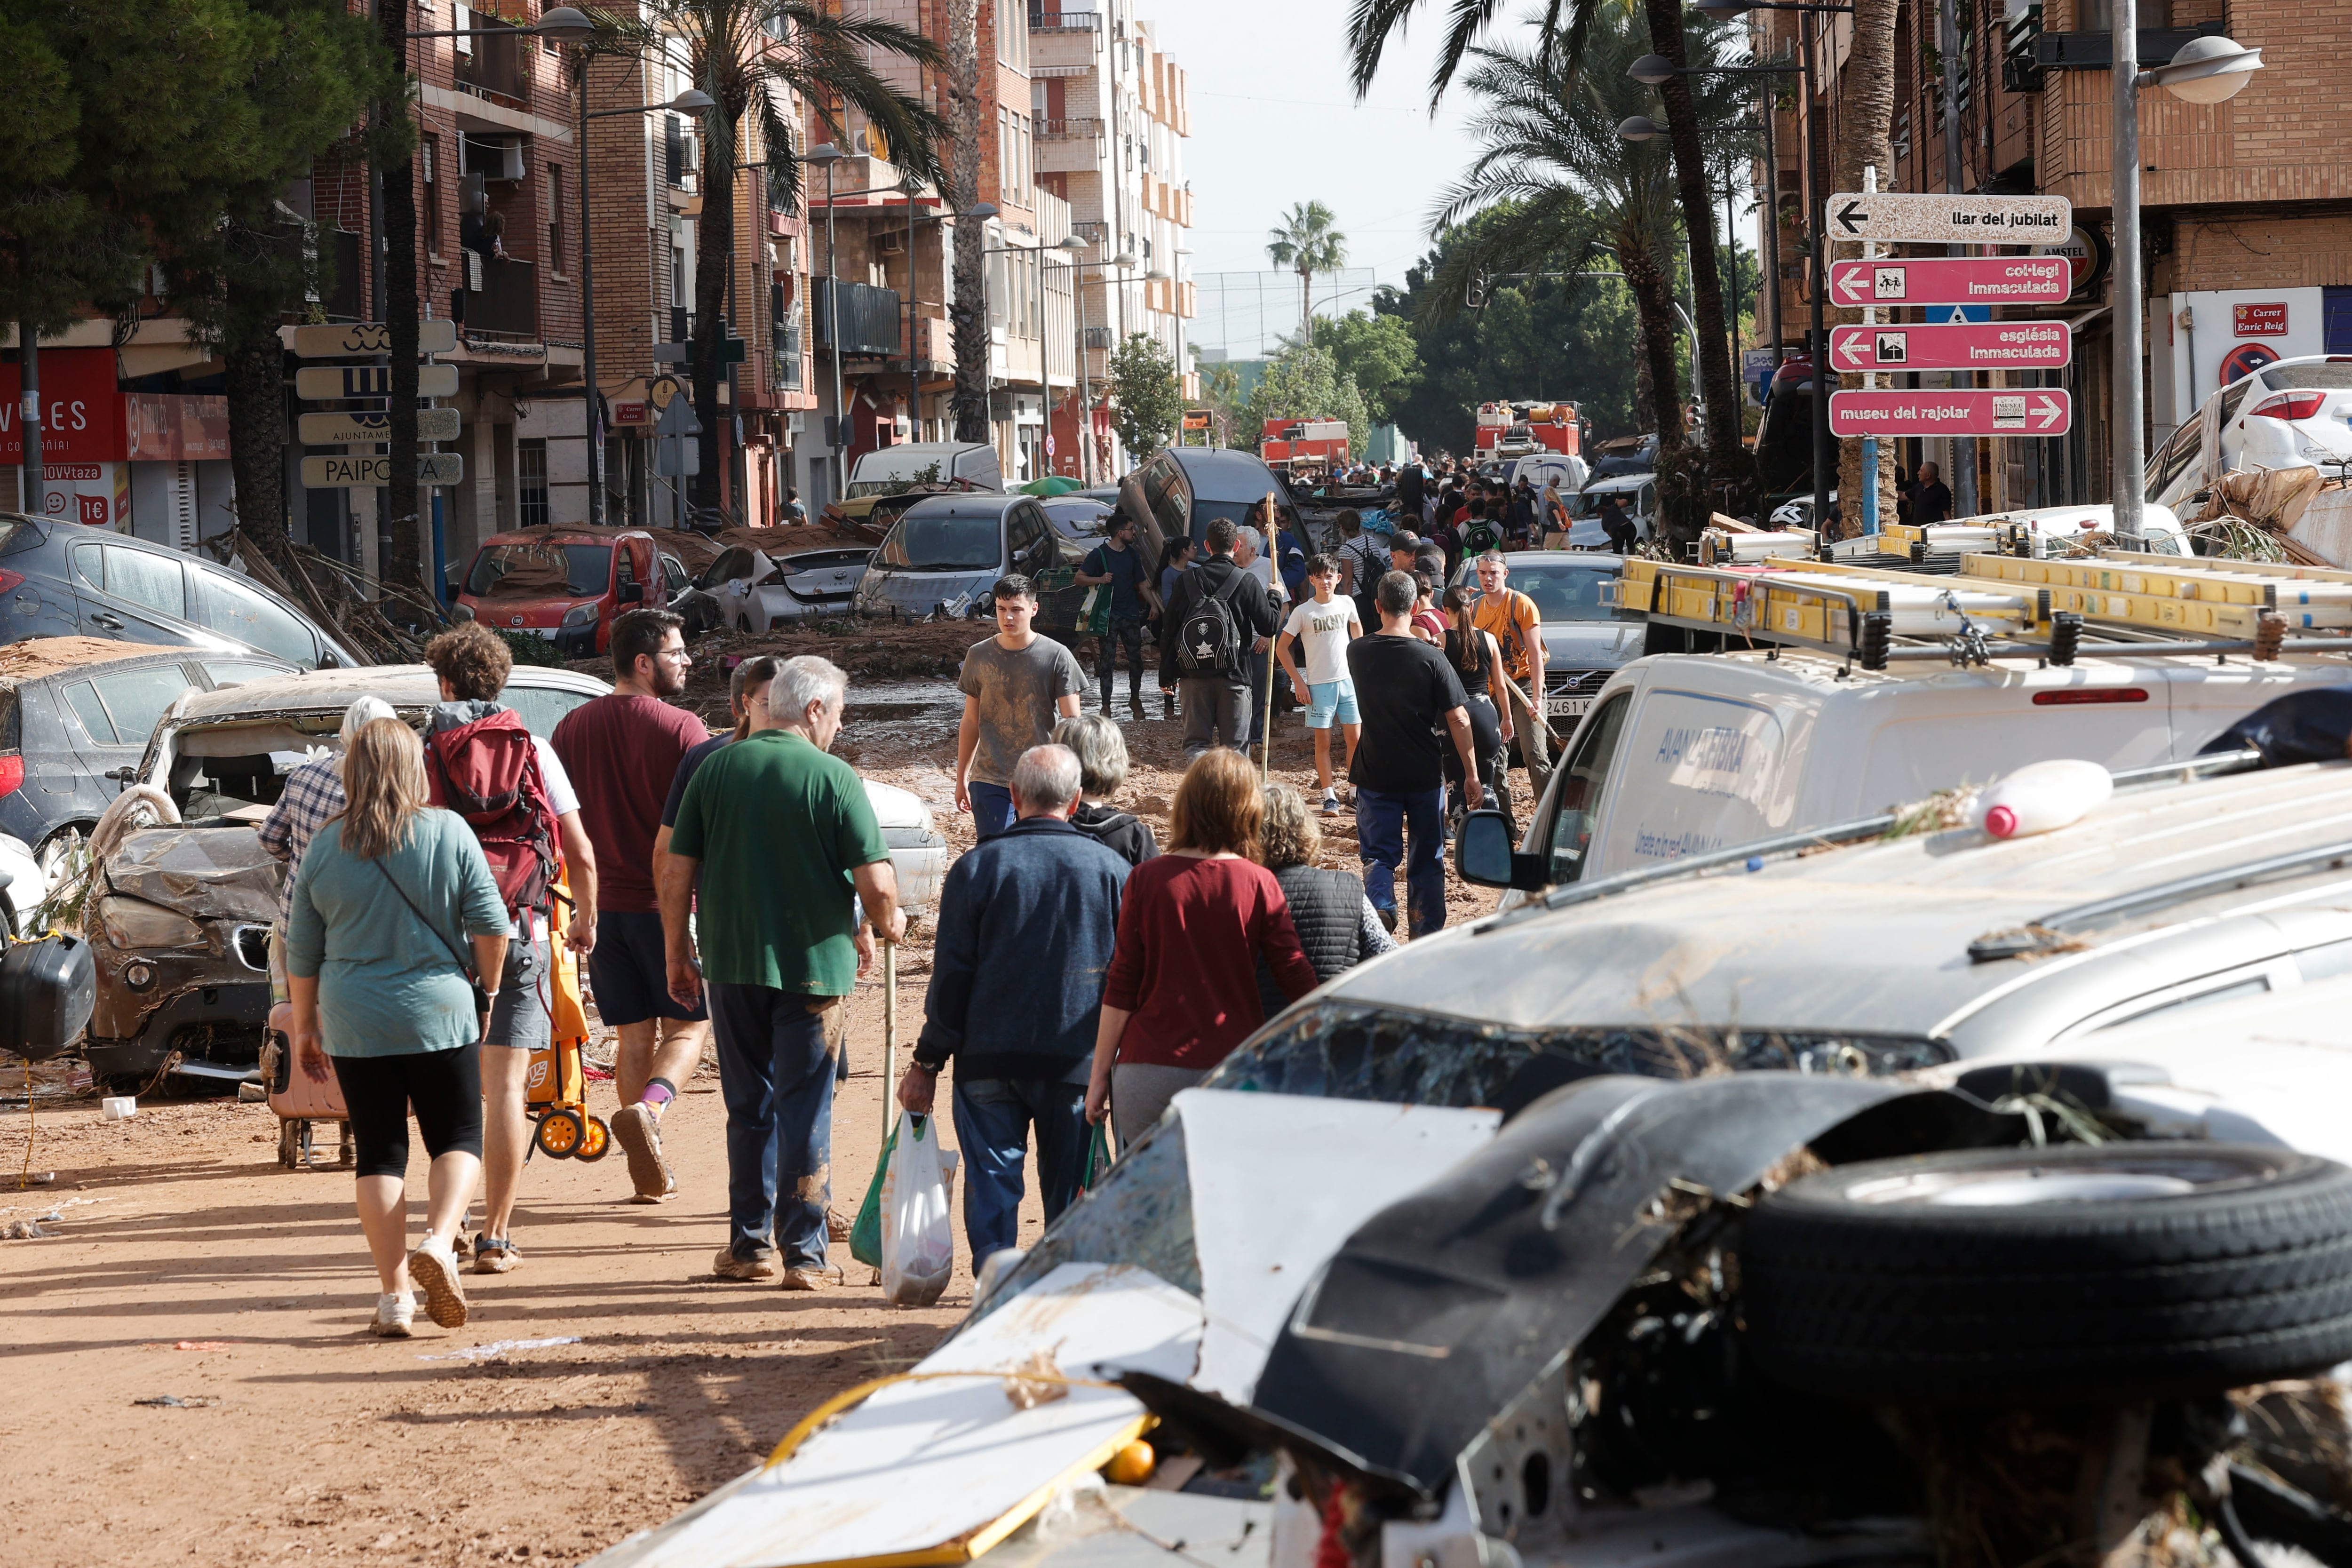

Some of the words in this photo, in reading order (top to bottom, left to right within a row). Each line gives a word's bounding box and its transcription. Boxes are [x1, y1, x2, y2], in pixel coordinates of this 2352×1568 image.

[1952, 212, 1977, 224] llar
[1982, 212, 2005, 225] del
[2009, 213, 2058, 228] jubilat
[2044, 247, 2084, 256] AMSTEL
[1969, 280, 2060, 295] Immaculada
[2253, 309, 2282, 317] Carrer
[2237, 323, 2262, 331] Enric
[2264, 322, 2284, 330] Reig
[1999, 327, 2060, 344] església
[1970, 344, 2061, 359] Immaculada
[1840, 409, 1890, 420] museu
[1893, 406, 1917, 419] del
[1921, 406, 1970, 421] rajolar
[85, 501, 103, 519] 1€
[1313, 613, 1345, 633] DKNY
